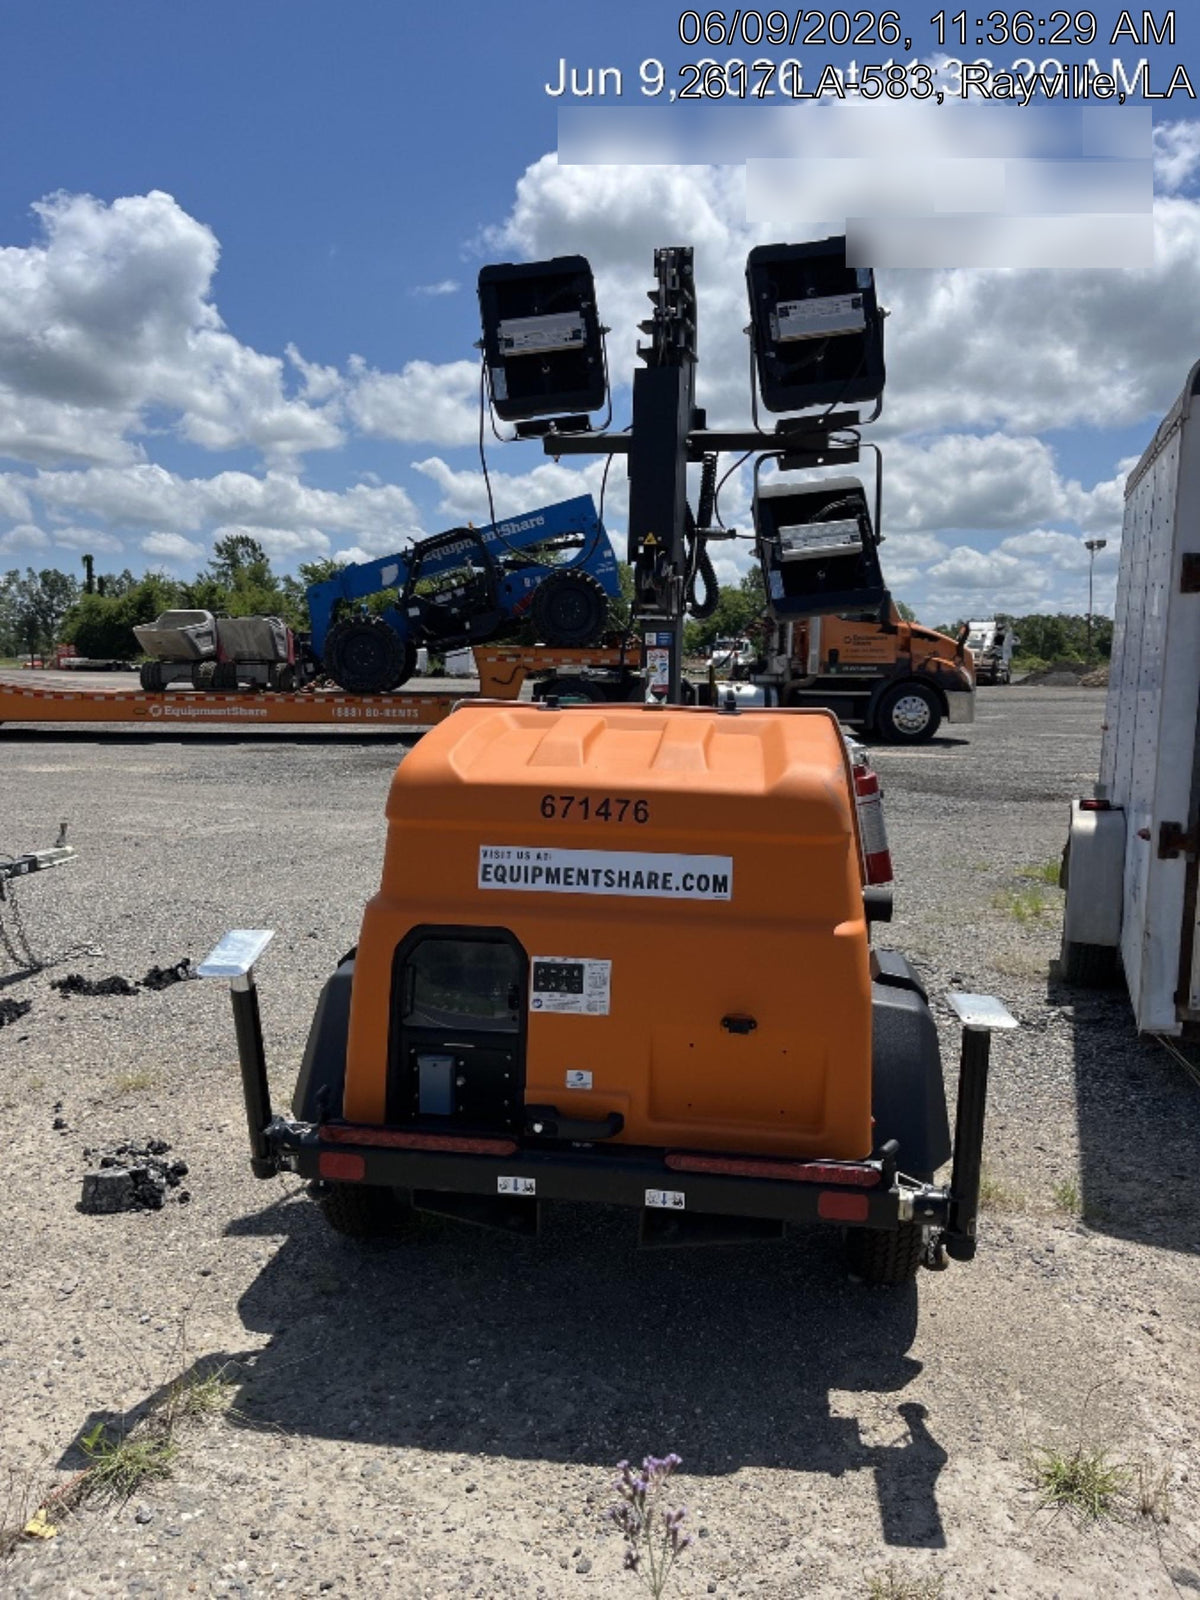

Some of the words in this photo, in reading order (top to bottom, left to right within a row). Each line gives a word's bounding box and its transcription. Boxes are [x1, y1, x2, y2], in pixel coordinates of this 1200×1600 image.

[164, 705, 267, 717] EquipmentShare
[540, 795, 650, 823] 671476
[482, 849, 511, 859] VISIT
[517, 850, 530, 860] US
[481, 863, 728, 893] EQUIPMENTSHARE.COM
